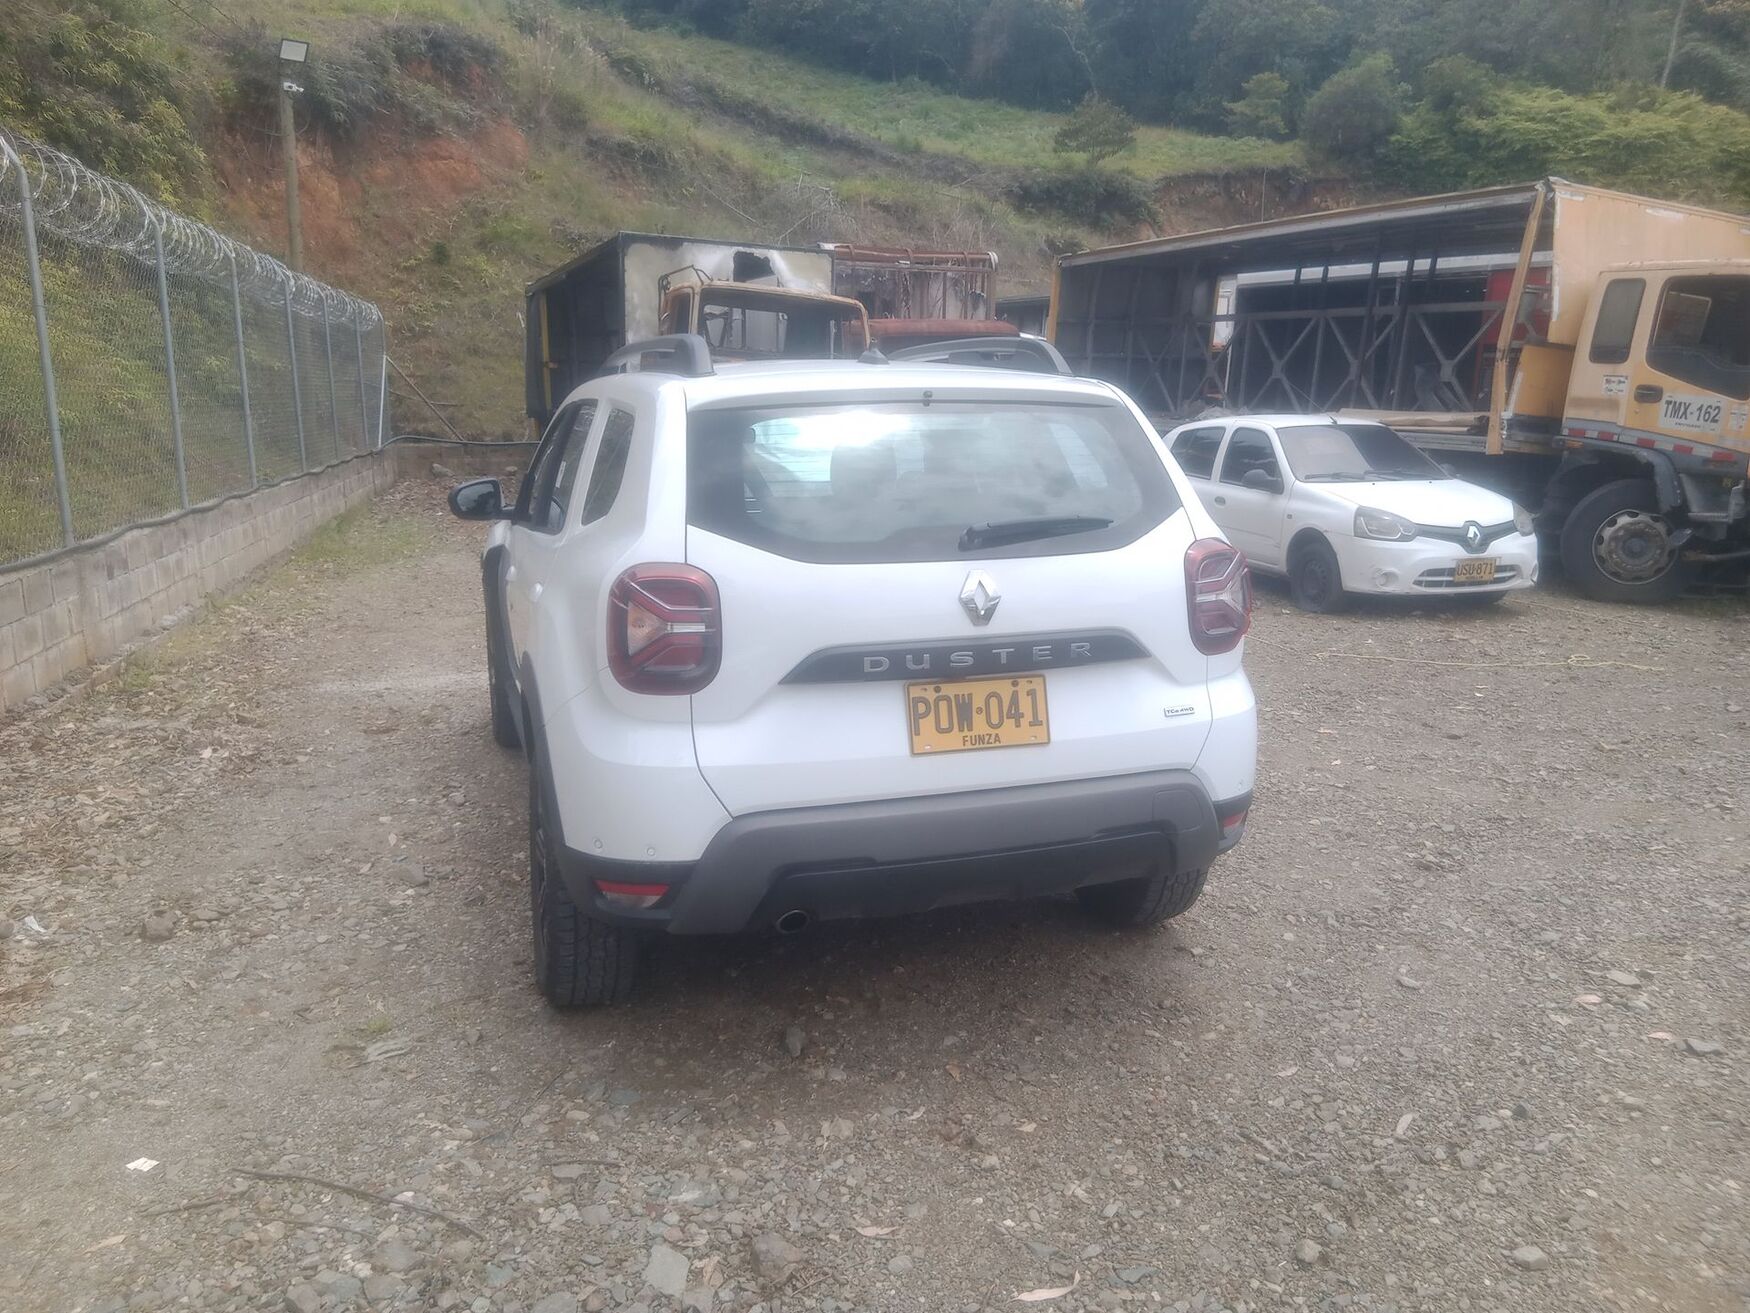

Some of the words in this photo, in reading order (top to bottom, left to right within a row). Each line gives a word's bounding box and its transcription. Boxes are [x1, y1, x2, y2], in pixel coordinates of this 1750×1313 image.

[1664, 400, 1722, 424] TMX-162
[863, 642, 1093, 673] DUSTER
[962, 733, 1001, 747] FUNZA
